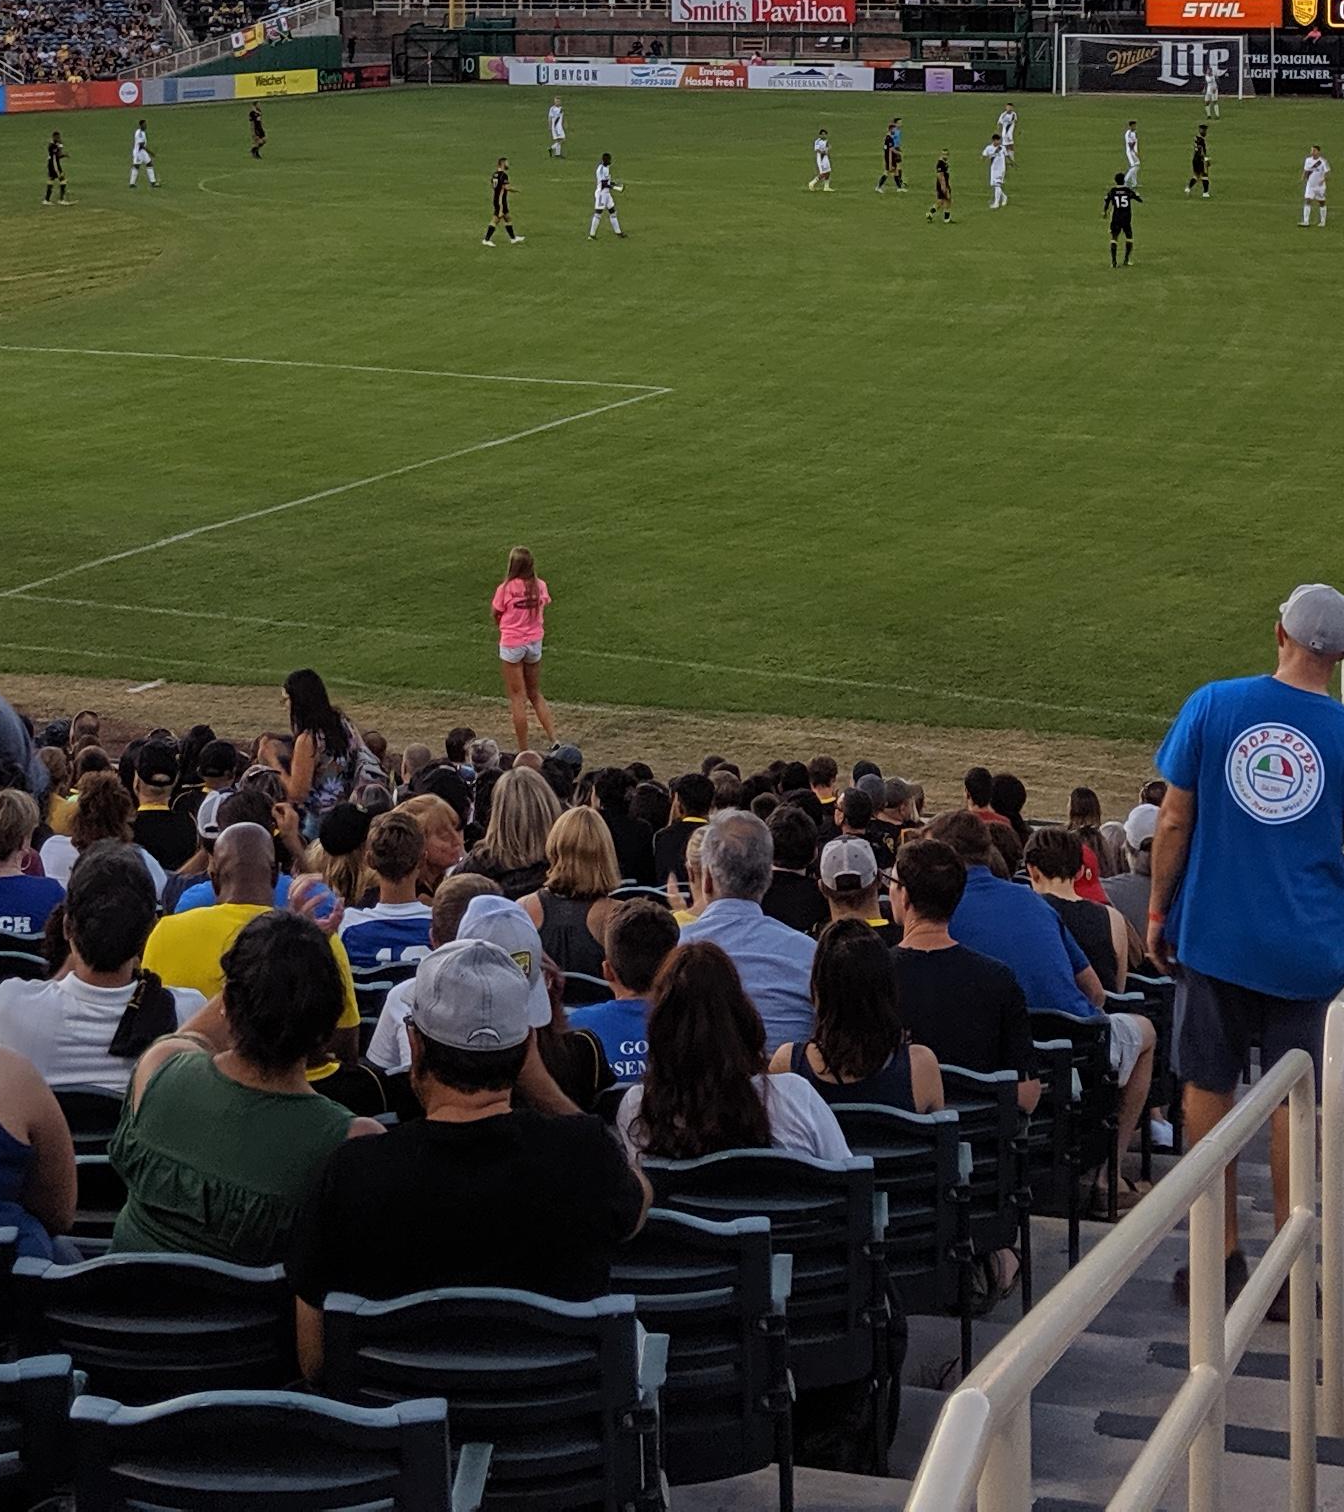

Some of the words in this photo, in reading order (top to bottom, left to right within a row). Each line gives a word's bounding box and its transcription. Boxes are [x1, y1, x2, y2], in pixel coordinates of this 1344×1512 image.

[1182, 2, 1246, 18] STIHL
[1107, 46, 1159, 72] Miller
[1157, 40, 1230, 86] Lite
[1243, 54, 1269, 64] THE
[1272, 54, 1330, 65] ORIGINAL
[699, 66, 735, 76] Envision
[1243, 69, 1279, 79] LIGHT
[685, 76, 714, 86] Hassle
[716, 77, 735, 87] Free
[737, 77, 745, 87] IT
[768, 80, 785, 88] BEN
[786, 79, 828, 88] SHERMAN
